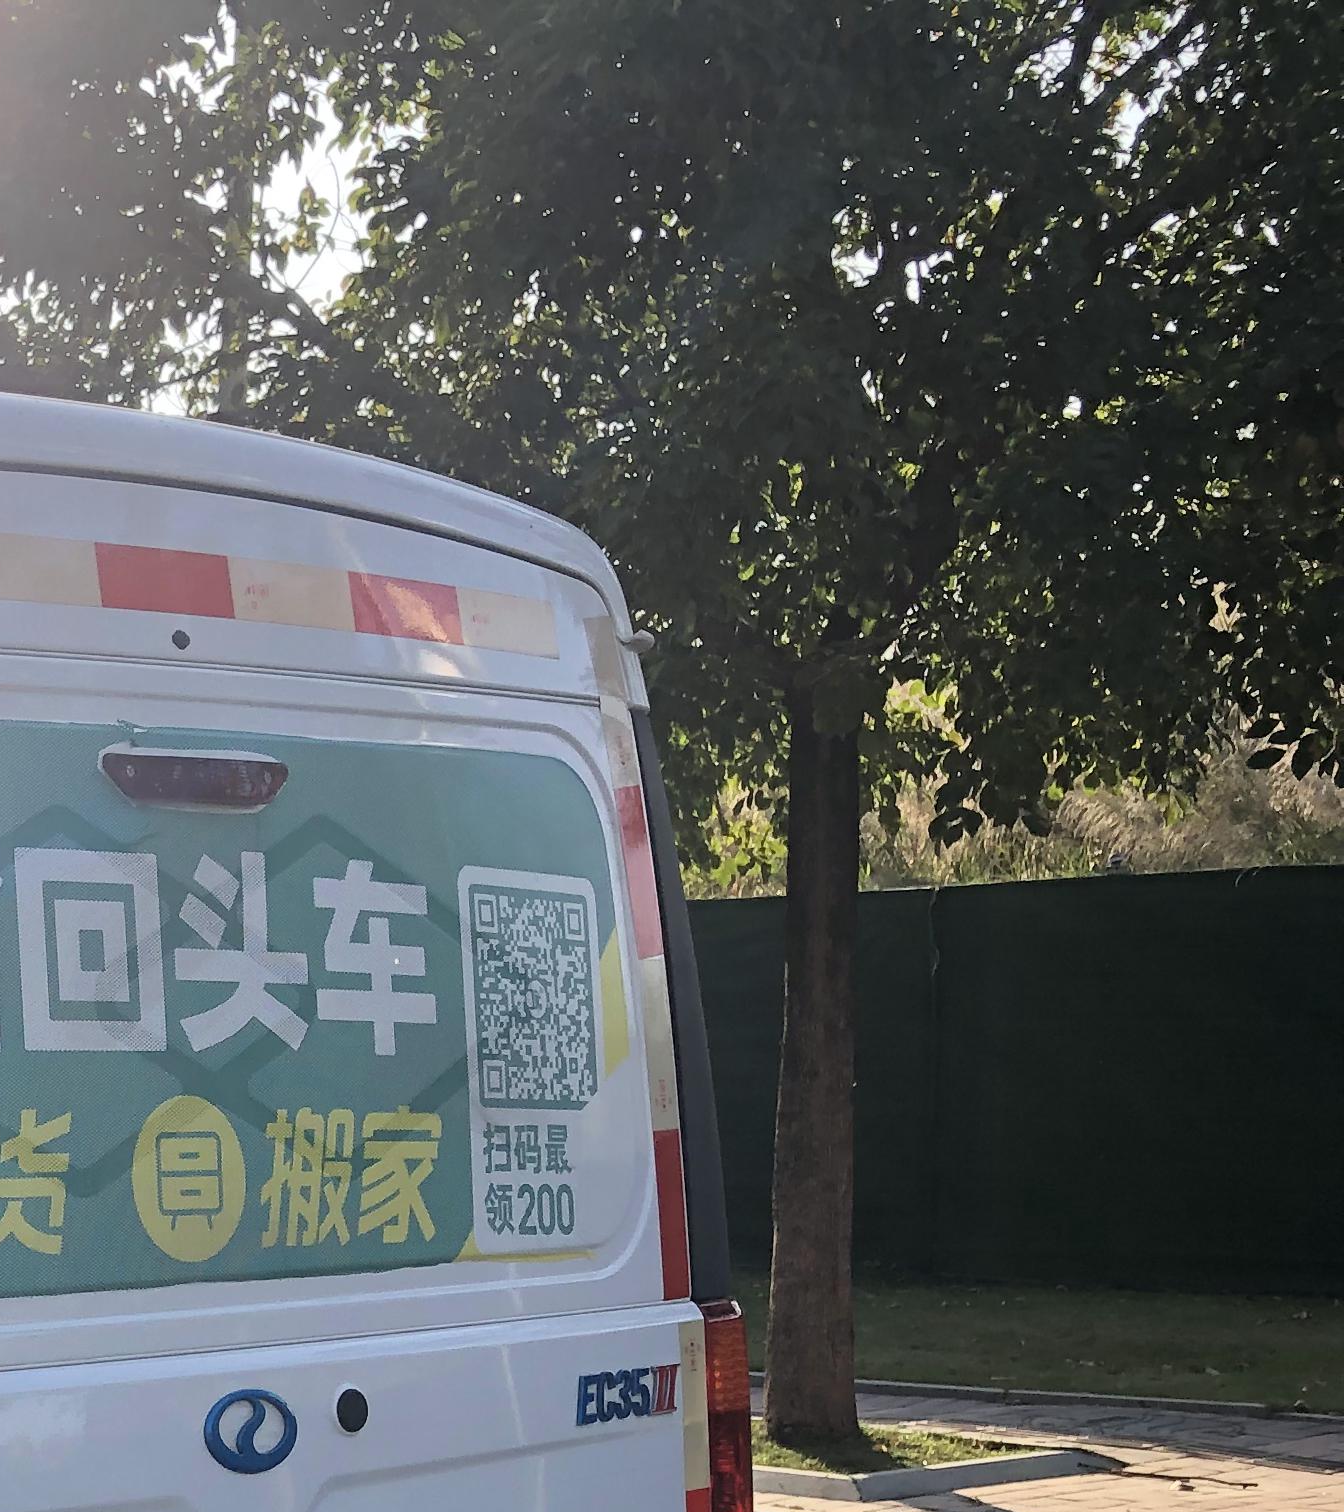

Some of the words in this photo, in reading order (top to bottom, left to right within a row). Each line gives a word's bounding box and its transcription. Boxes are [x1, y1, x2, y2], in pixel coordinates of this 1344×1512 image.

[483, 1122, 572, 1174] 扫码最
[259, 1105, 444, 1249] 搬家
[484, 1183, 575, 1235] 领200
